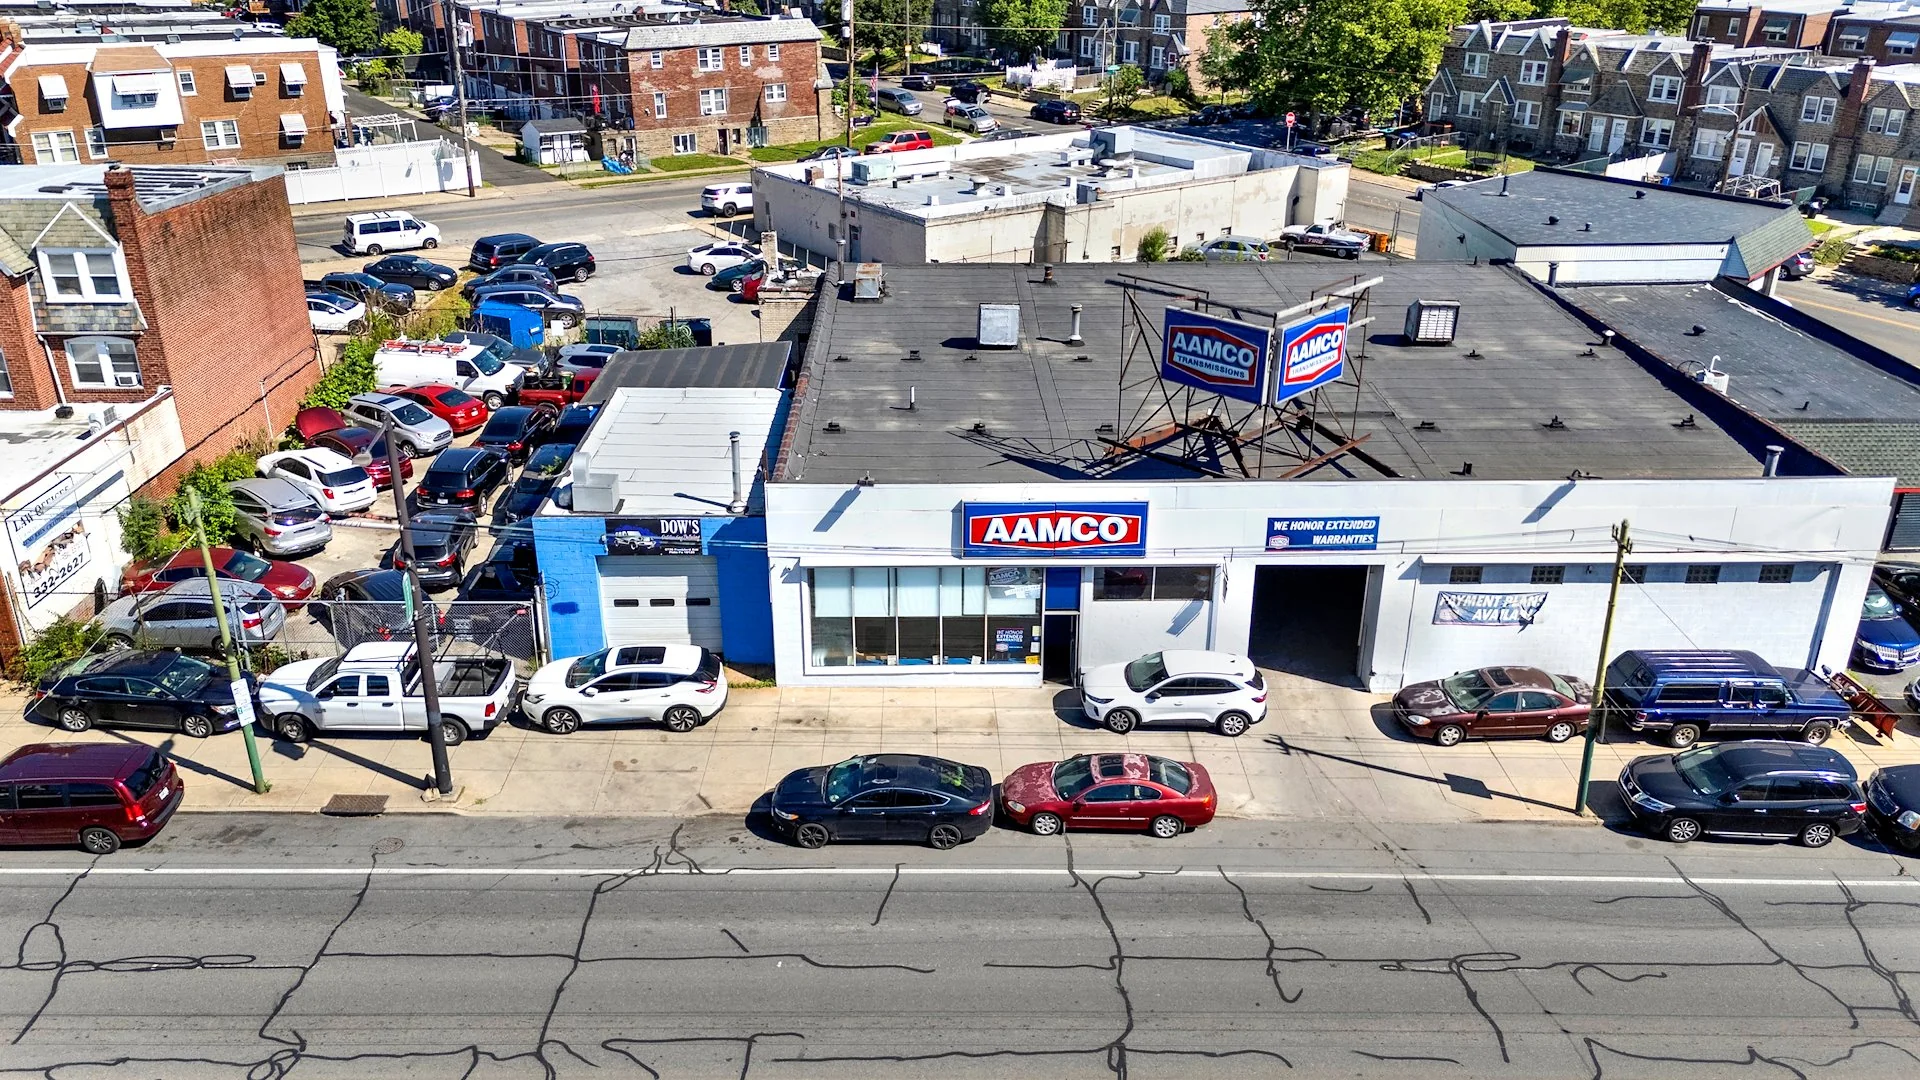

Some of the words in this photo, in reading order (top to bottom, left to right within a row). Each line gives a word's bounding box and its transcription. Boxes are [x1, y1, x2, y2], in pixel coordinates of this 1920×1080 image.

[1172, 332, 1255, 368] AAMCO
[1288, 329, 1343, 367] AAMCO
[1177, 354, 1245, 379] TRANSMISSIONS
[1292, 354, 1336, 375] TRANSMISSIONS
[13, 512, 34, 532] LAW
[660, 519, 700, 534] DOW'S
[983, 516, 1128, 543] AAMCO
[1274, 521, 1290, 531] WE
[1290, 520, 1324, 531] HONOR
[1325, 519, 1376, 530] EXTENDED
[1312, 534, 1375, 545] WARRANTIES
[33, 552, 84, 598] 332-2627
